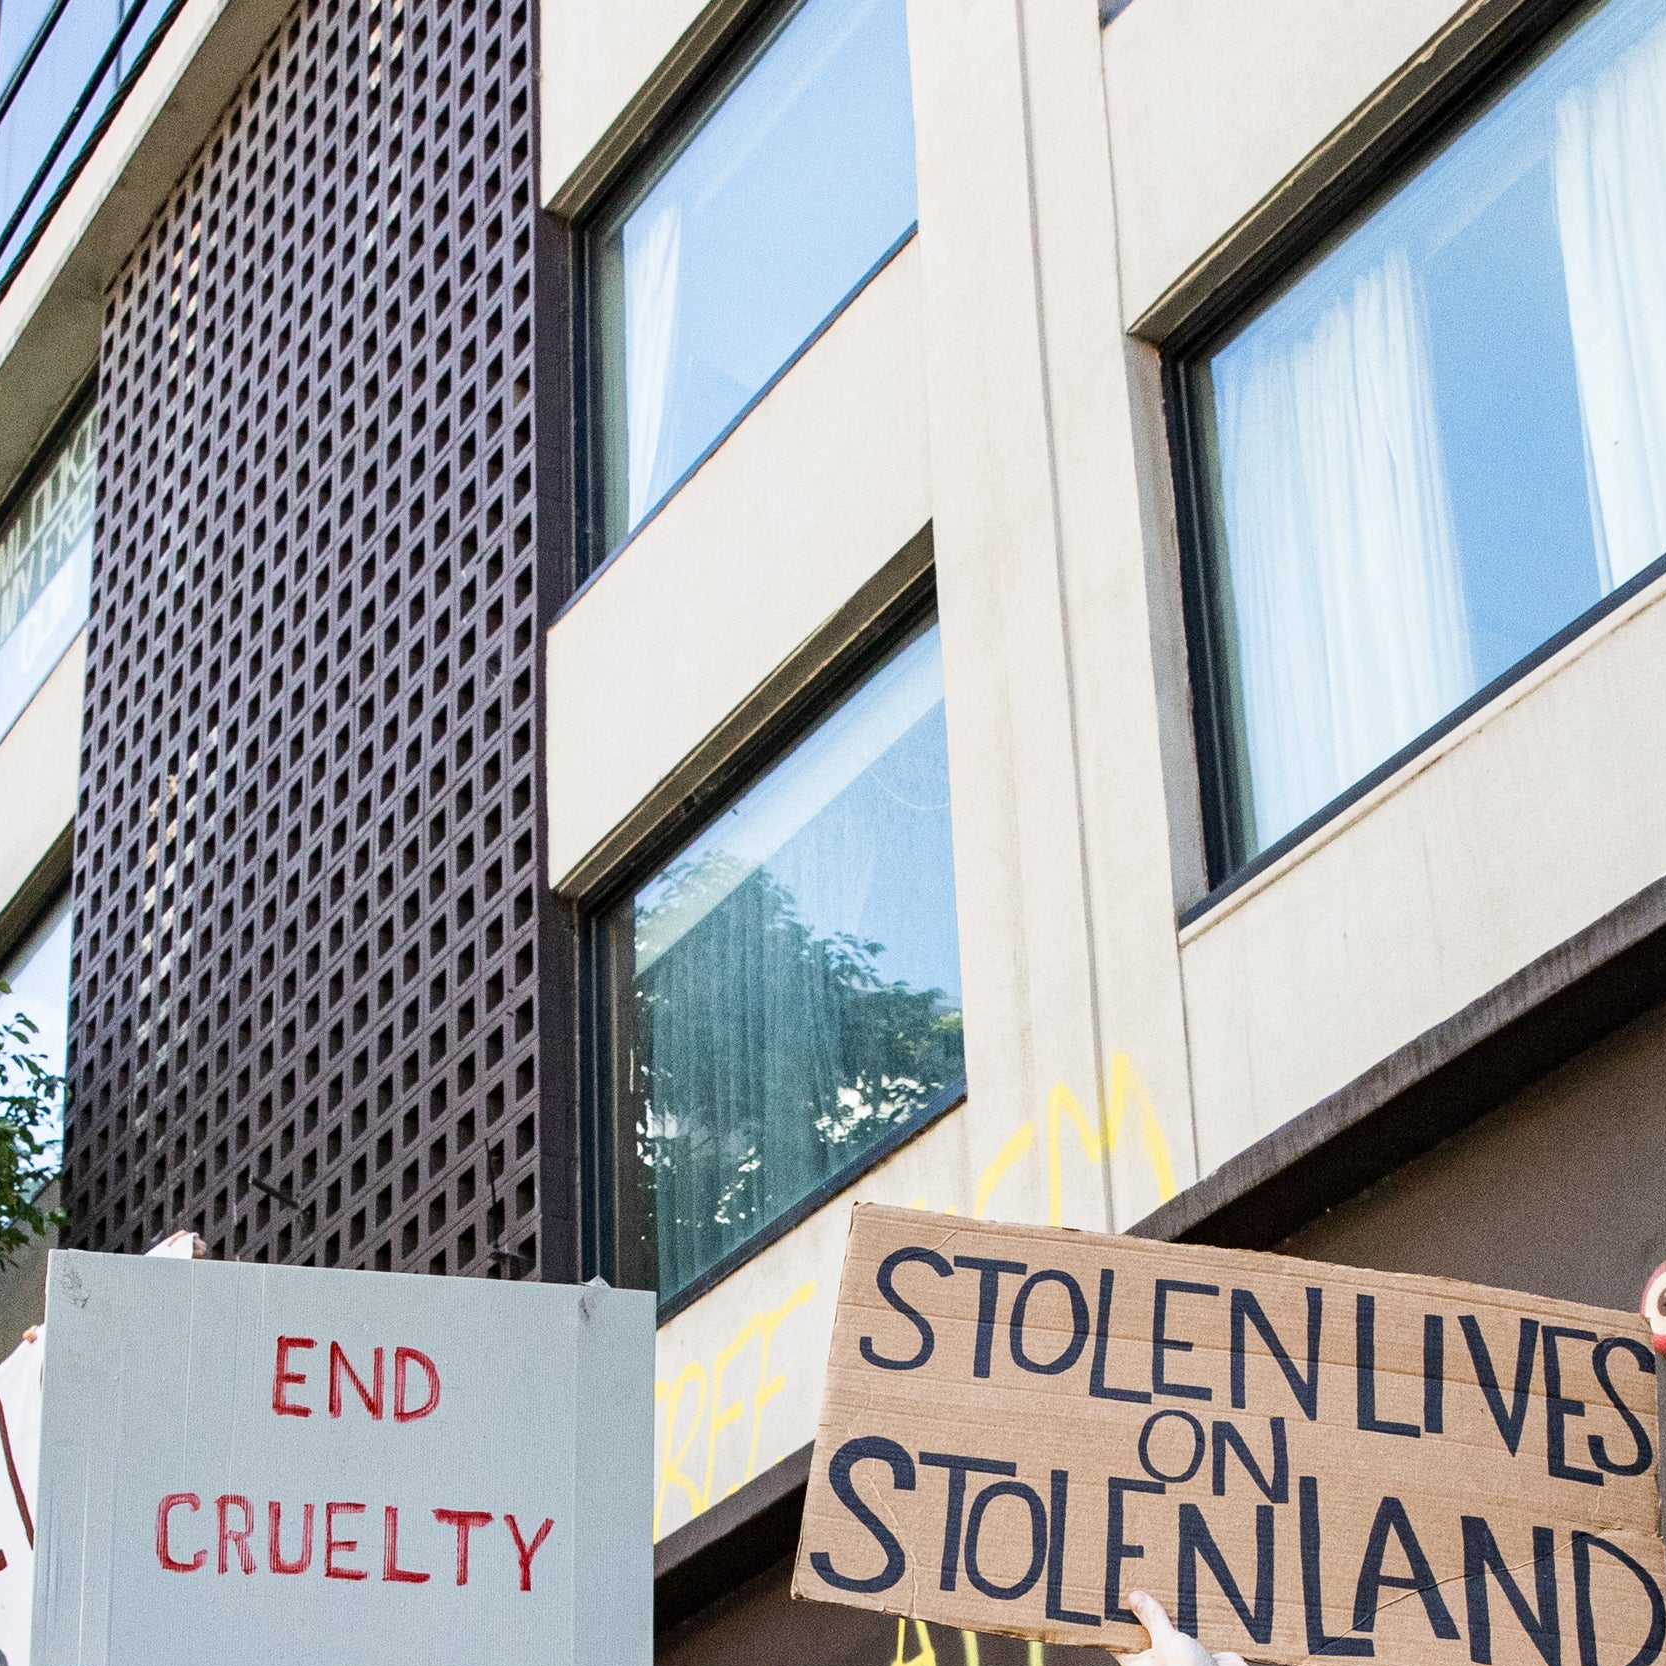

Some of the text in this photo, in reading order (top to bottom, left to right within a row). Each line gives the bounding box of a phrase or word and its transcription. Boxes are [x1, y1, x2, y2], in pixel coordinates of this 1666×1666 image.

[272, 1335, 442, 1423] END
[654, 1280, 817, 1545] REE
[859, 1247, 1657, 1487] STOLEN LIVES
[1137, 1410, 1290, 1504] ON
[155, 1492, 555, 1591] CRUELTY
[810, 1435, 1276, 1644] STOLEN
